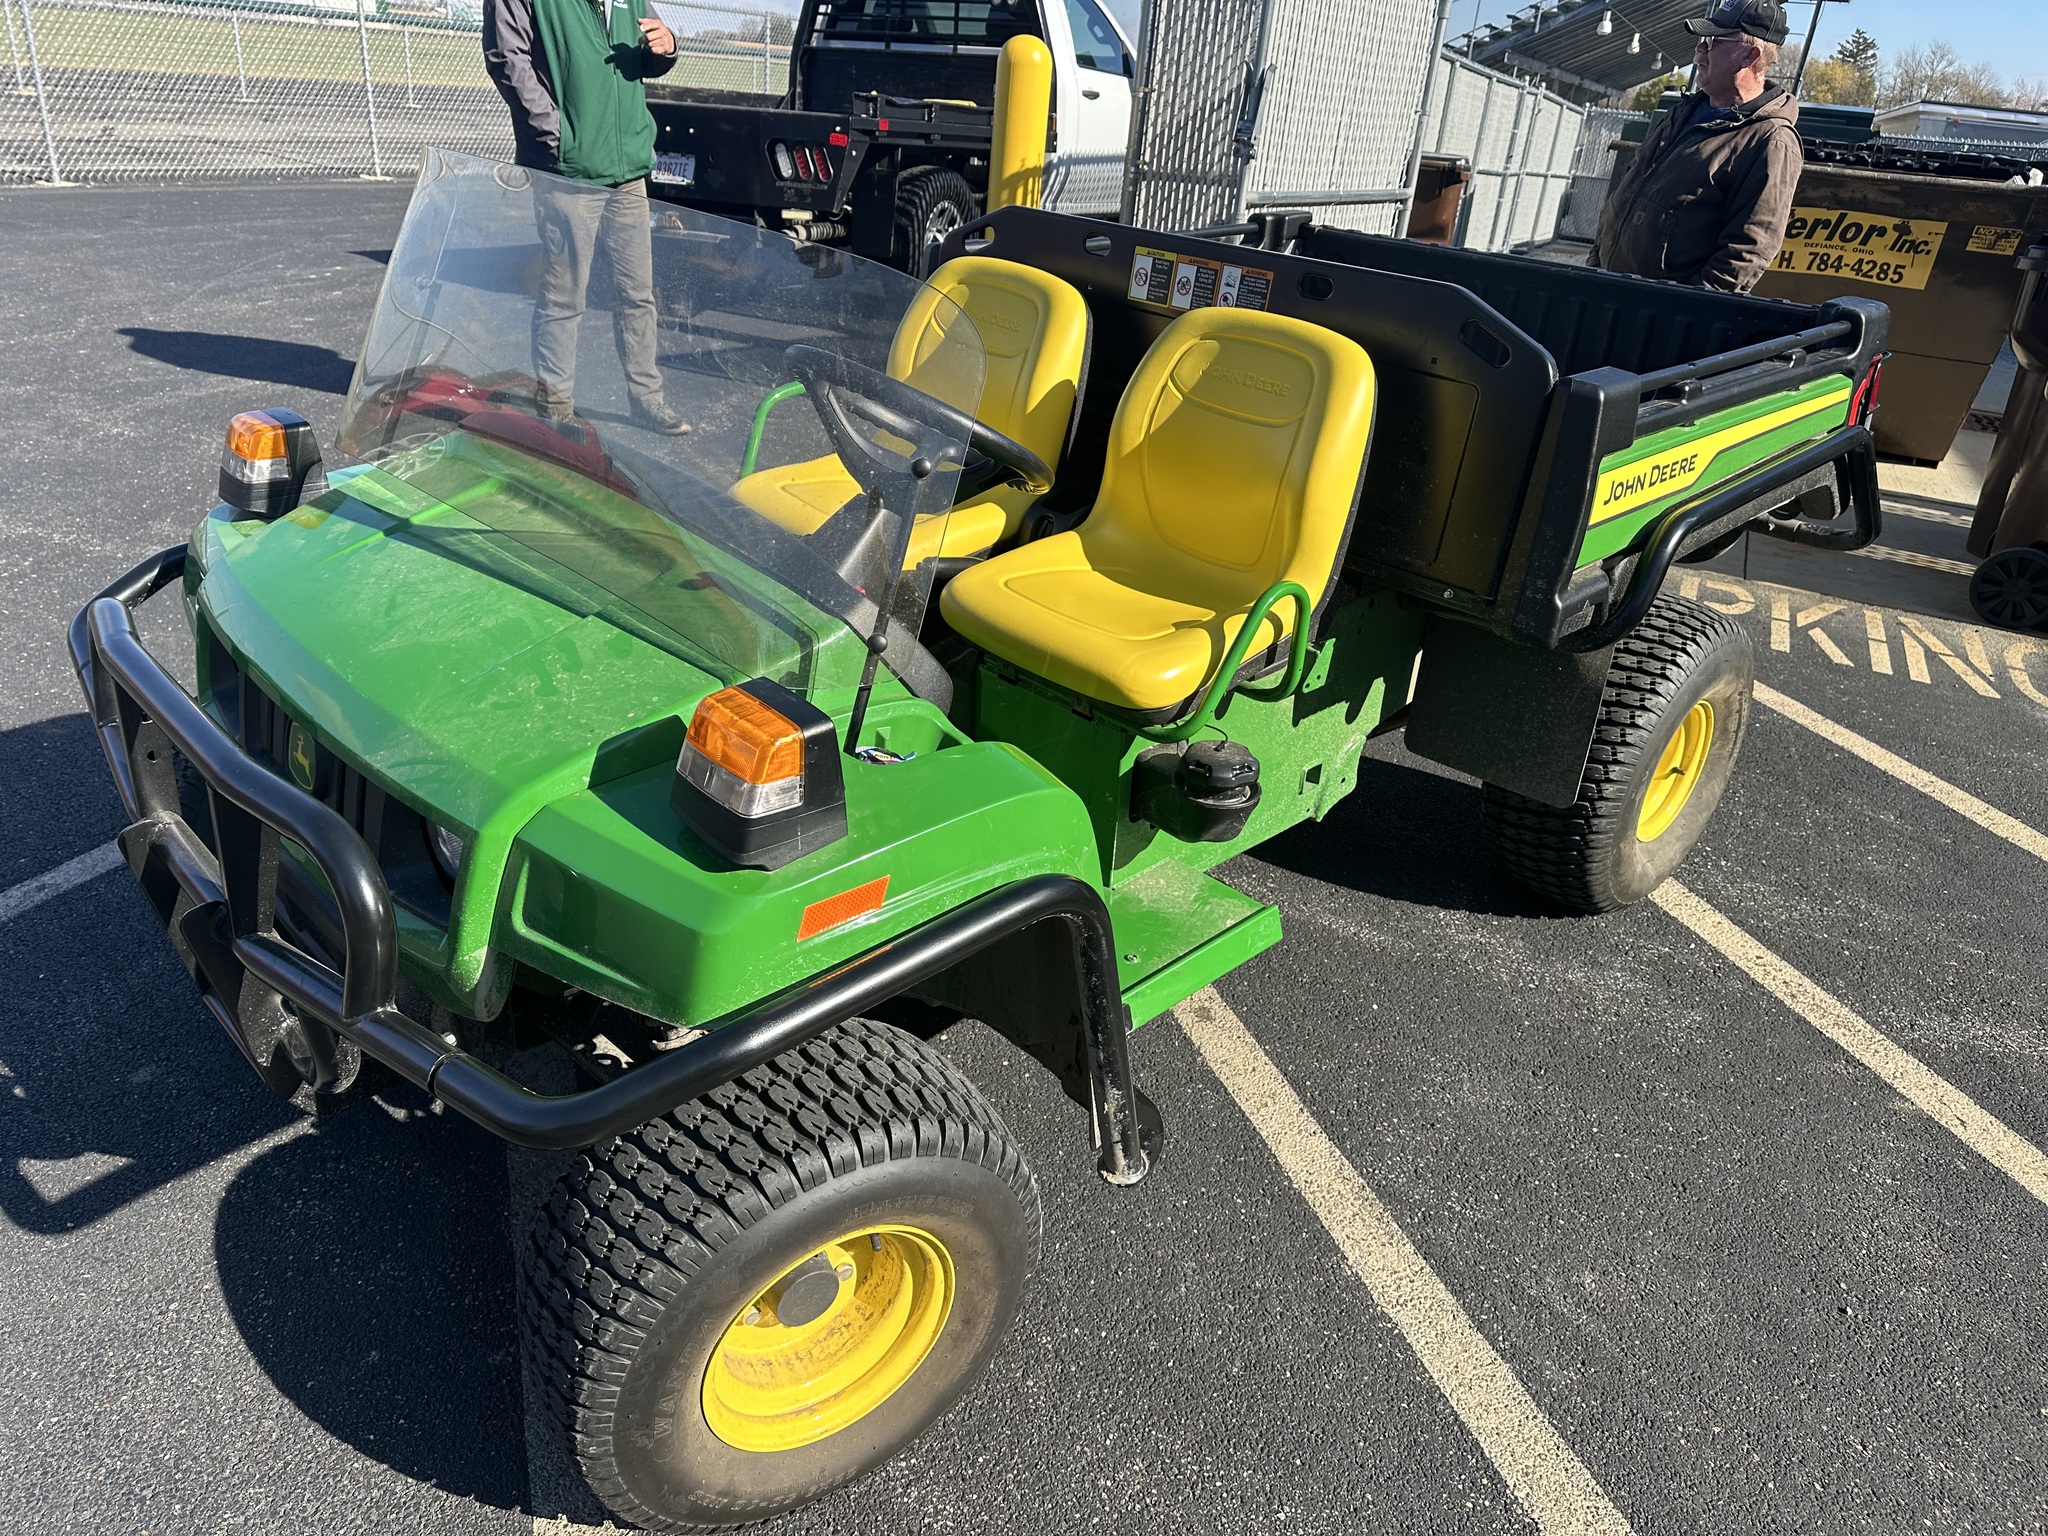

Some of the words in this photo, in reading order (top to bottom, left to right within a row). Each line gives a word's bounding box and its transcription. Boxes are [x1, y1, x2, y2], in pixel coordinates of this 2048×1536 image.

[1785, 210, 1888, 247] erlor
[1803, 242, 1848, 252] DEFIANCE,
[1852, 247, 1875, 256] OHIO
[1774, 250, 1796, 270] H.
[1805, 251, 1907, 284] 784-4285
[1242, 371, 1291, 398] DEERE
[1603, 472, 1647, 506] JOHN
[1648, 453, 1699, 489] DEERE
